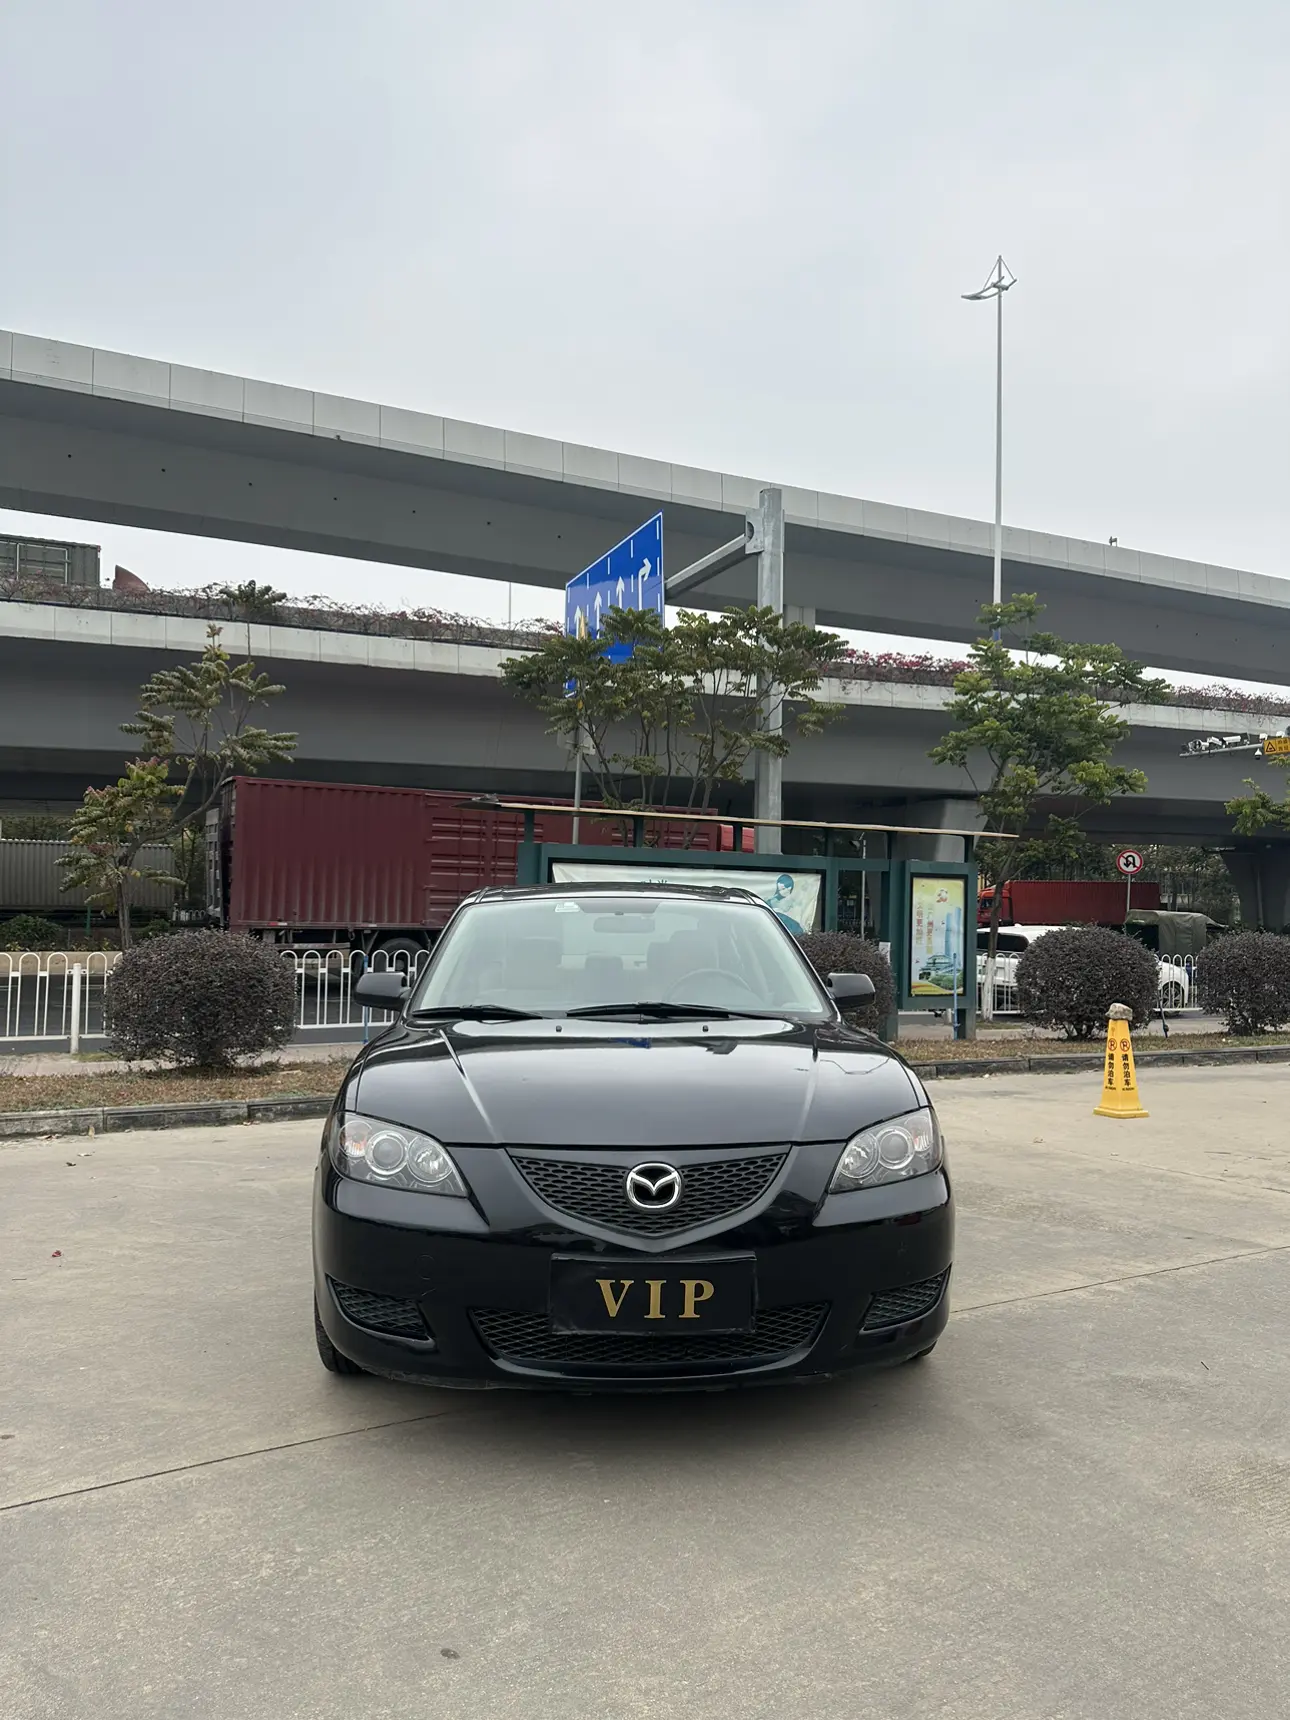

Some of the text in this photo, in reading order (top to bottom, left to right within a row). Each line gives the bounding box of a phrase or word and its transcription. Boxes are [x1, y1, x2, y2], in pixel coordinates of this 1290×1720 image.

[1121, 1054, 1131, 1086] 请勿泊车
[595, 1279, 715, 1319] VIP
